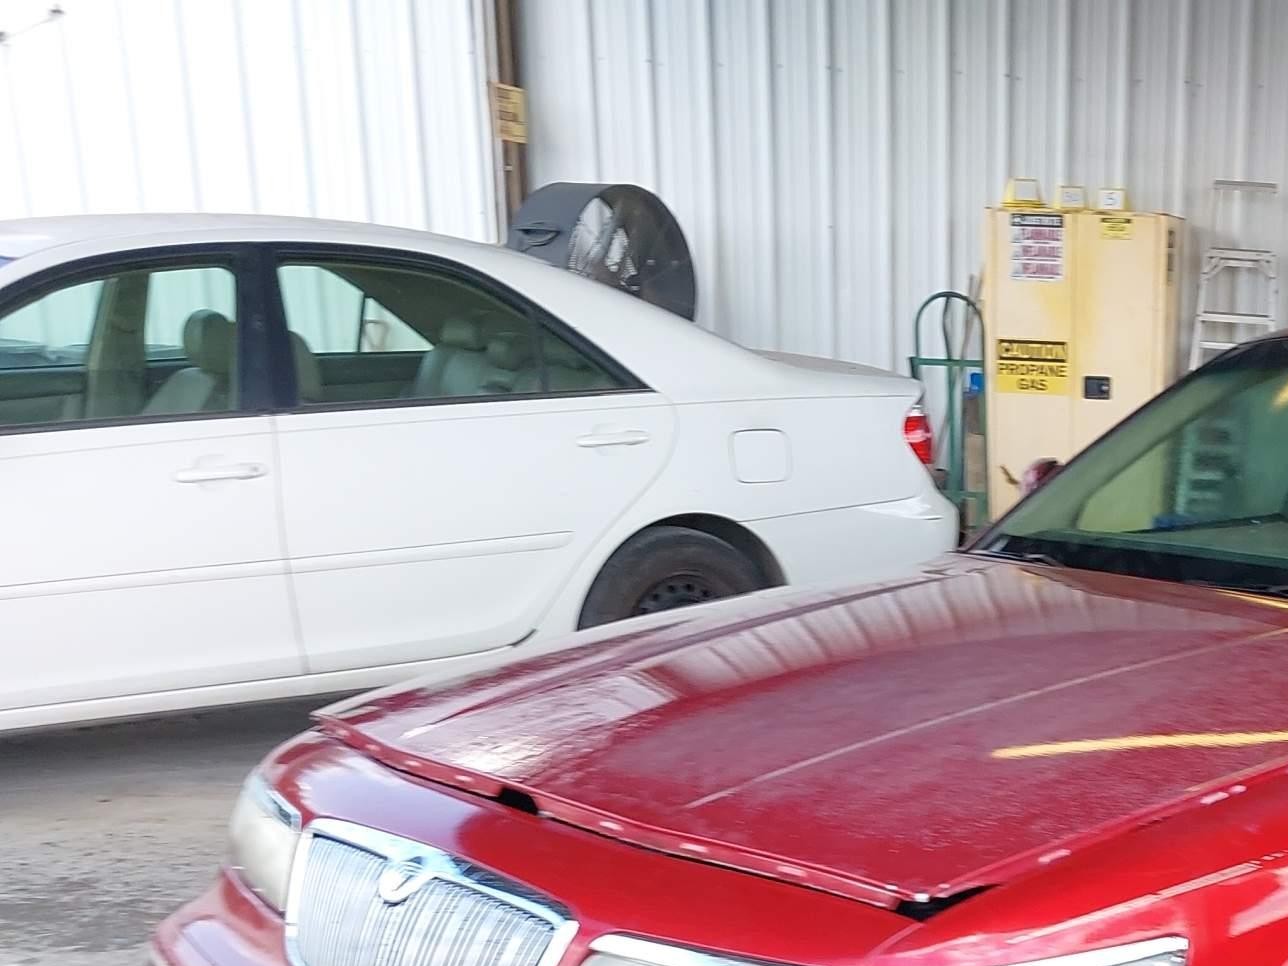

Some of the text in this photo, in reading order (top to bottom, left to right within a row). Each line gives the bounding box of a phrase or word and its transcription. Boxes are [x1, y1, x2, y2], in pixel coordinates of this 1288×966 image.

[1000, 342, 1067, 359] CAUTION
[998, 363, 1067, 378] PROPANE
[1017, 379, 1049, 391] GAS
